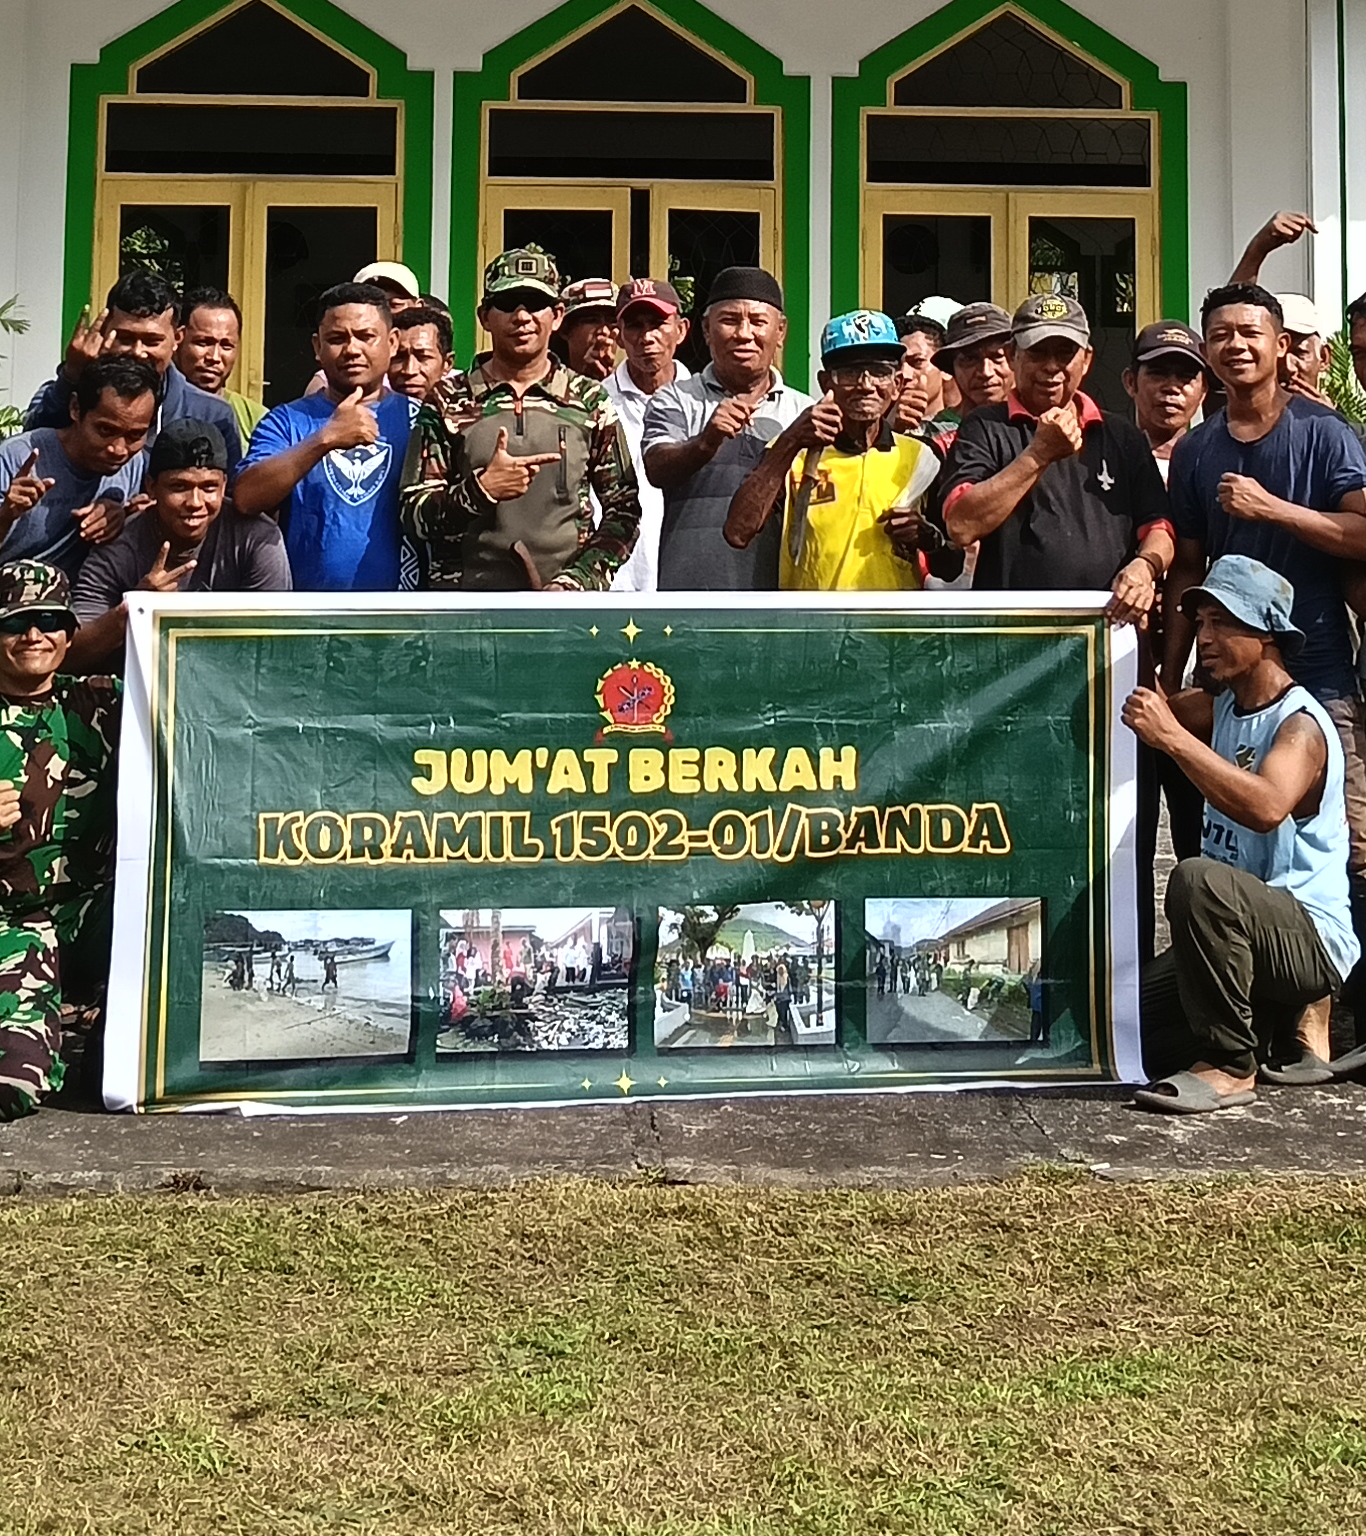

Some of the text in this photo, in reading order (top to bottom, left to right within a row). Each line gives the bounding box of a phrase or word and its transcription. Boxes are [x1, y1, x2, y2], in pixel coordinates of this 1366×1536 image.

[630, 279, 657, 298] M
[411, 746, 858, 795] JUM'AT BERKAH
[259, 802, 1012, 865] KORAMIL 1502-01/BANDA
